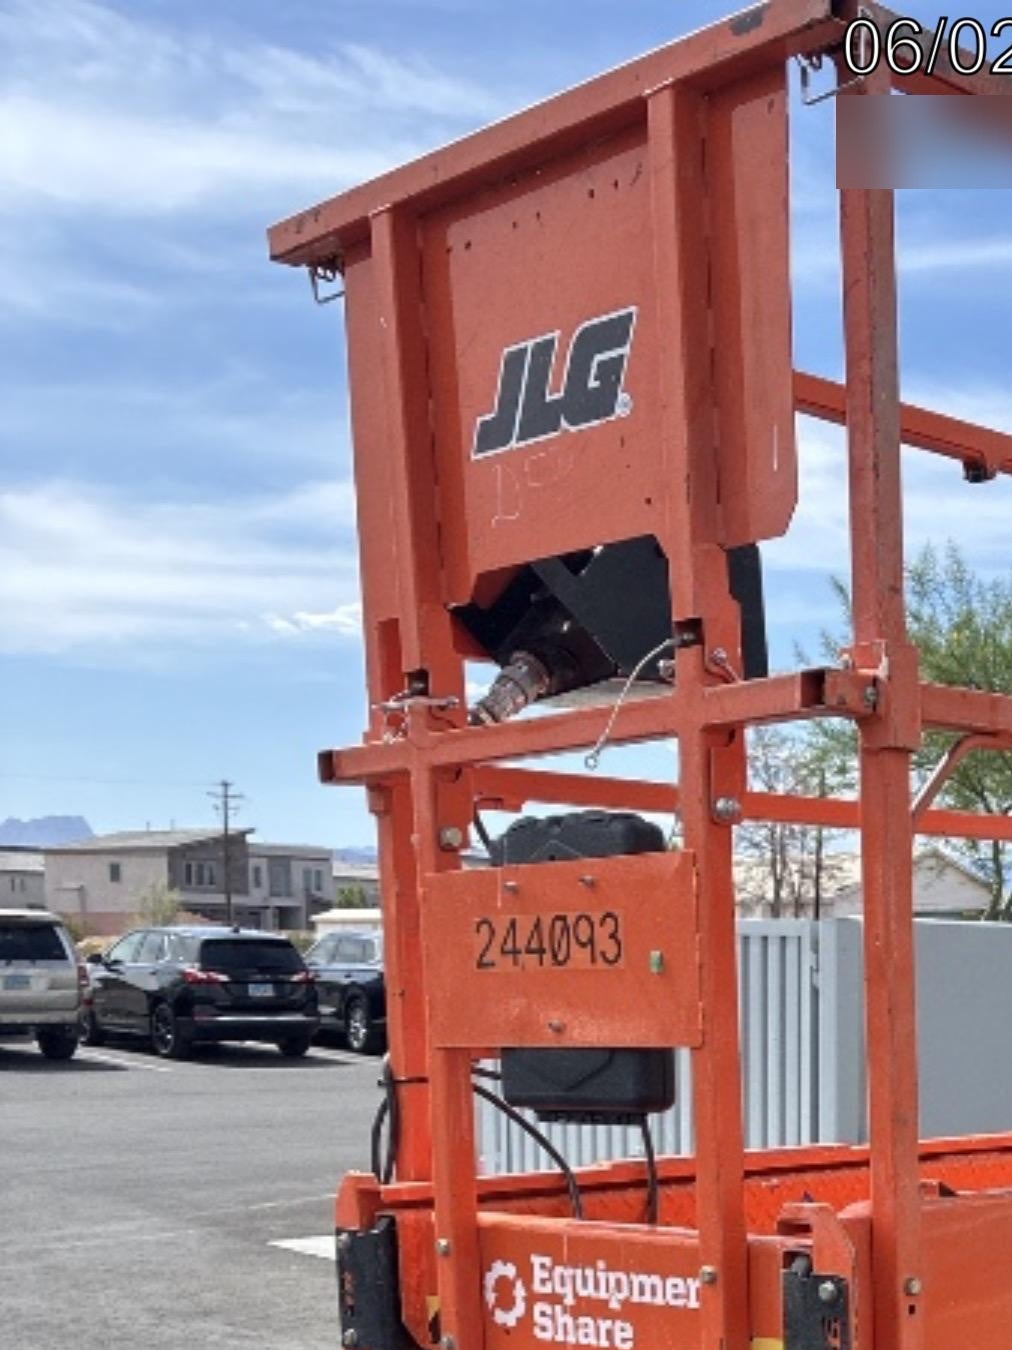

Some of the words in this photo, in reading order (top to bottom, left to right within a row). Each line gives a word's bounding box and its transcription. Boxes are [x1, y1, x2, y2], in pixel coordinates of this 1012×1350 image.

[471, 306, 637, 461] JLG
[475, 911, 622, 969] 244093
[533, 1302, 634, 1350] Share
